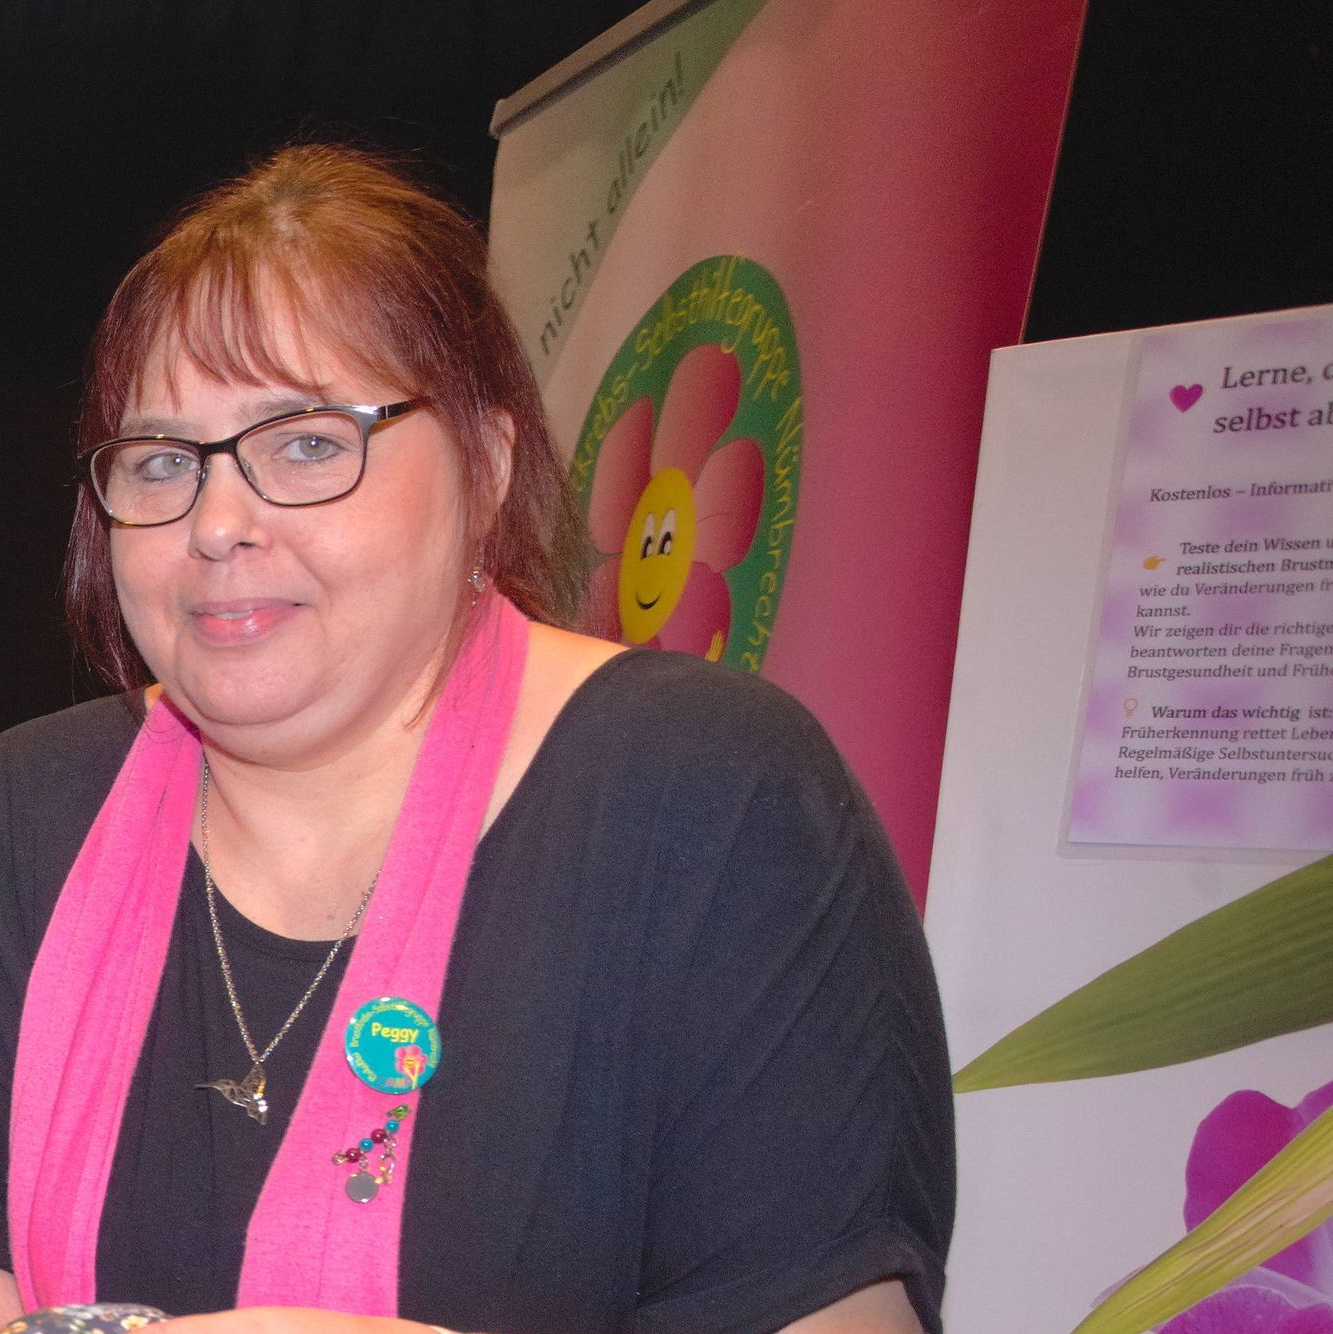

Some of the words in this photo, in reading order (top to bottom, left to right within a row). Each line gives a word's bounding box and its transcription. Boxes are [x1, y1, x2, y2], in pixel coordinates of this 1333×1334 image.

[539, 219, 599, 355] nicht
[606, 52, 682, 215] allein!
[1221, 363, 1313, 390] Lerne,
[1213, 406, 1300, 434] selbst
[1150, 485, 1231, 502] Kostenlos
[1180, 541, 1221, 555] Teste
[1223, 540, 1259, 554] dein
[1264, 537, 1320, 552] Wissen
[1176, 560, 1275, 576] realistischen
[1139, 584, 1166, 597] wie
[1170, 583, 1190, 597] du
[1194, 580, 1314, 597] Veränderungen
[1136, 604, 1191, 618] kannst.
[1133, 624, 1162, 638] Wir
[1165, 625, 1214, 641] zeigen
[1218, 622, 1242, 637] dir
[1244, 622, 1269, 636] die
[1130, 645, 1227, 659] beantworten
[1231, 644, 1275, 657] deine
[1279, 642, 1333, 659] Fragen
[1127, 666, 1253, 681] Brustgesundheit
[1257, 665, 1288, 678] und
[1151, 705, 1207, 719] Warum
[1211, 705, 1238, 719] das
[1242, 705, 1301, 722] wichtig
[1308, 706, 1333, 719] ist:
[1121, 726, 1239, 742] Früherkennung
[1242, 727, 1287, 740] rettet
[1118, 745, 1215, 762] Regelmäßige
[1114, 766, 1164, 781] helfen,
[1168, 767, 1286, 784] Veränderungen
[1290, 767, 1324, 782] früh
[371, 1021, 419, 1043] Peggy
